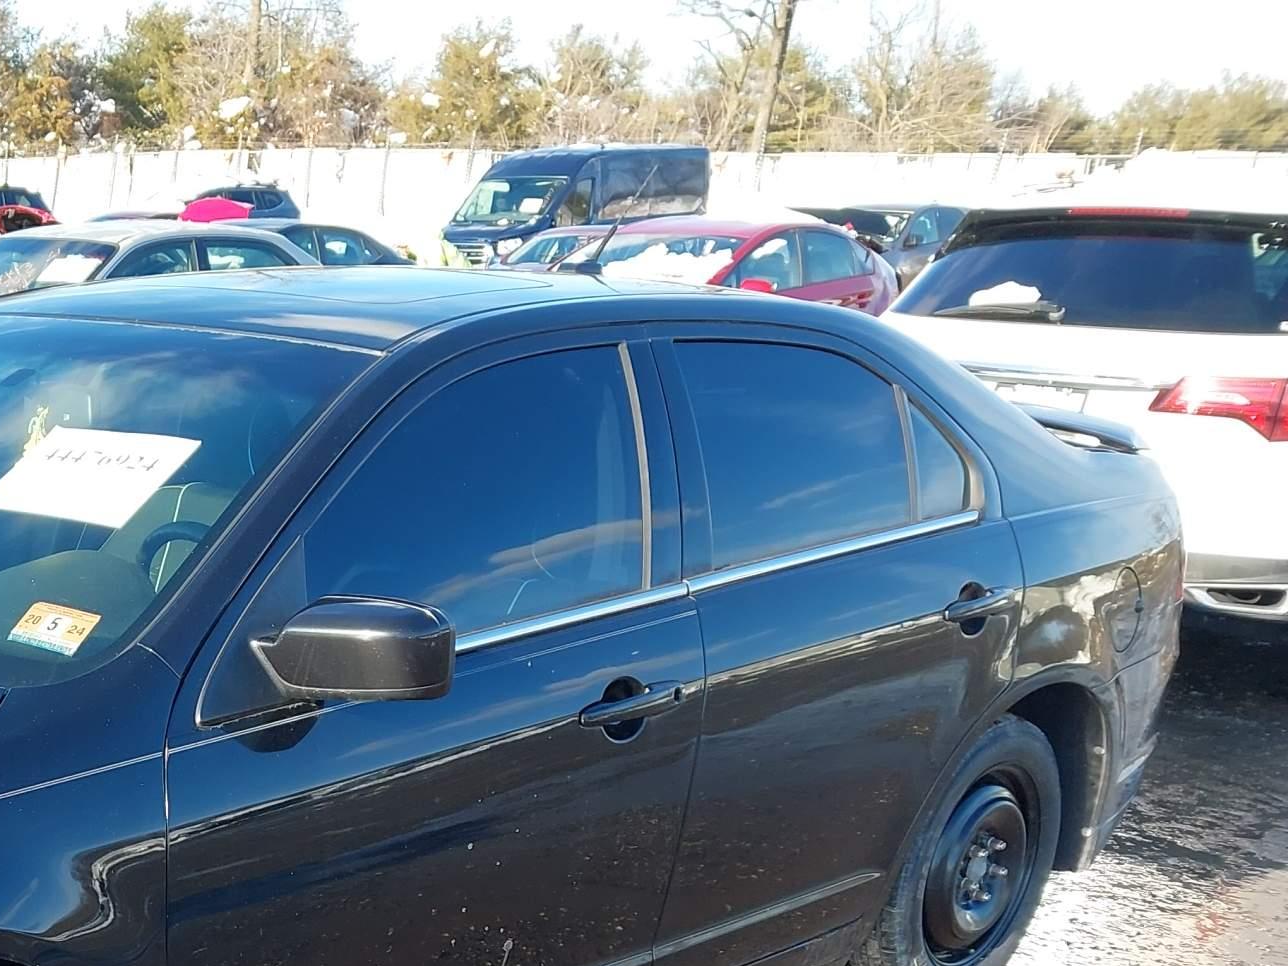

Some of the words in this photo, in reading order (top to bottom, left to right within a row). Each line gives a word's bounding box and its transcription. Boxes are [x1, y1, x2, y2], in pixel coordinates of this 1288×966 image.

[25, 614, 42, 625] 20
[46, 617, 63, 631] 5
[67, 624, 86, 636] 24
